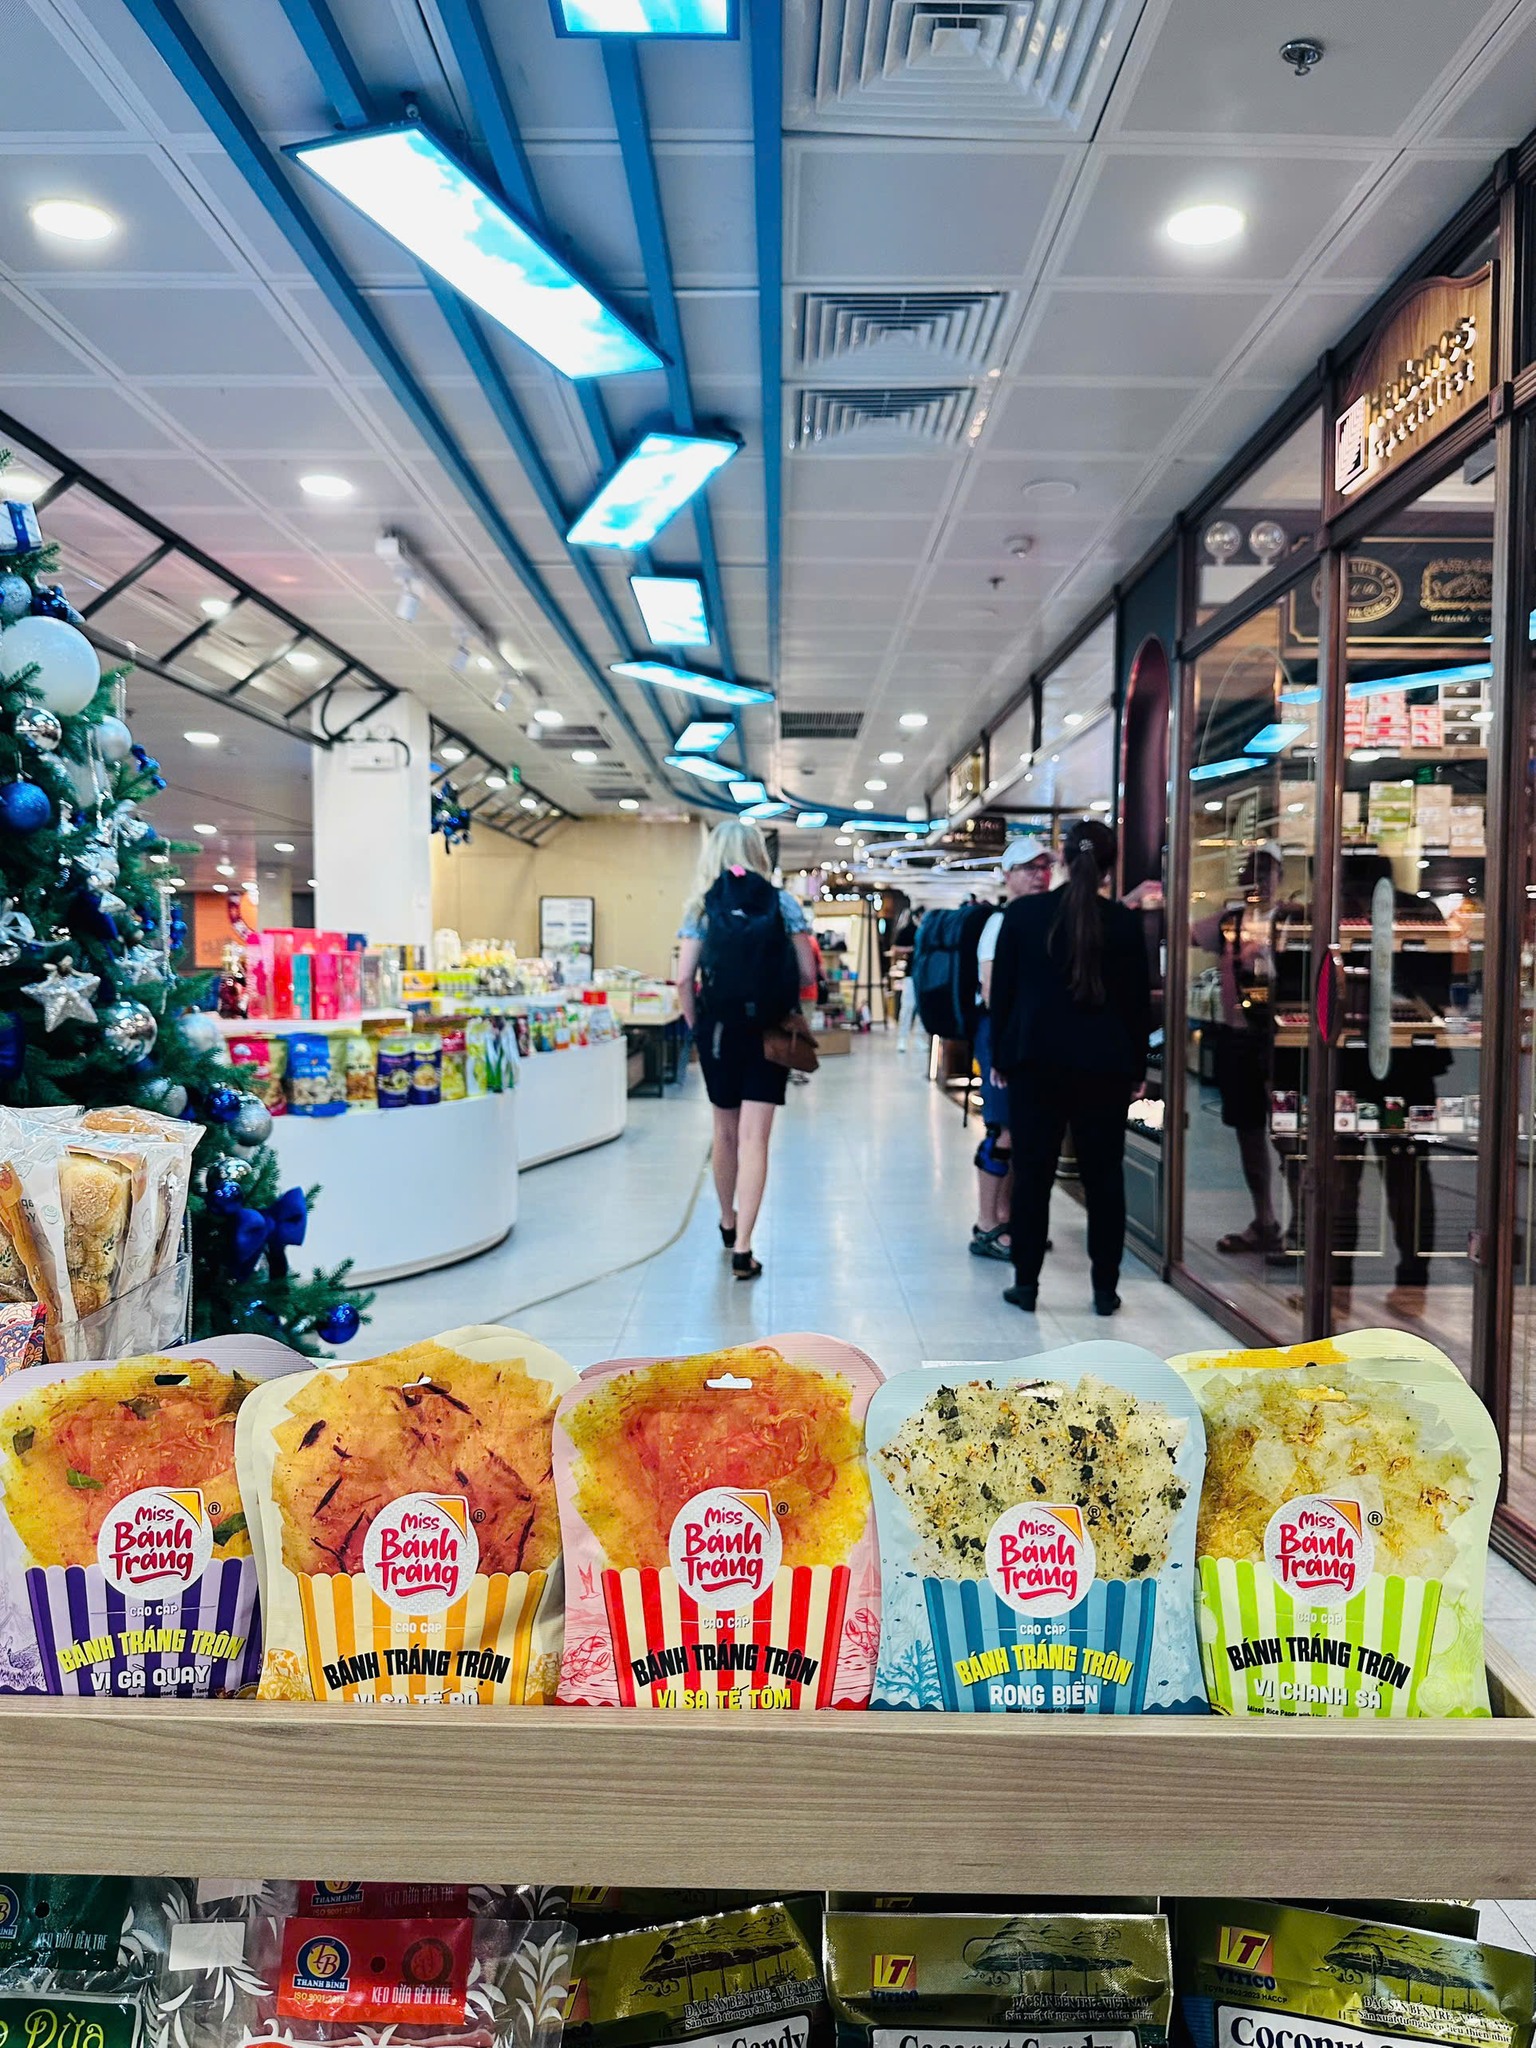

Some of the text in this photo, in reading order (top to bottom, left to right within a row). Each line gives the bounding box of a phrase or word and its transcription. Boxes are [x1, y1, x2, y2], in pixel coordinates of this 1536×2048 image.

[134, 1506, 174, 1525] Miss
[401, 1512, 440, 1533] Miss
[703, 1507, 743, 1528] Miss
[1018, 1519, 1056, 1539] Miss
[1298, 1510, 1335, 1530] Miss
[114, 1519, 193, 1553] Bánh
[380, 1528, 458, 1562] Bánh
[684, 1522, 762, 1557] Bánh
[999, 1534, 1075, 1567] Bánh
[1279, 1524, 1354, 1559] Bánh
[108, 1550, 194, 1580] Tráng
[375, 1559, 460, 1597] Tráng
[680, 1554, 764, 1590] Tráng
[1275, 1554, 1356, 1592] Tráng
[997, 1563, 1078, 1600] Tráng
[130, 1605, 152, 1617] CAO
[703, 1617, 724, 1629] CAO
[1297, 1612, 1318, 1623] CAO
[1020, 1624, 1042, 1635] CAO
[56, 1625, 246, 1673] BÁNH TRÁNG TRỘN
[631, 1639, 819, 1688] BÁNH TRÁNG TRỘN
[954, 1639, 1134, 1686] BÁNH TRÁNG TRỘN
[1226, 1633, 1411, 1690] BÁNH TRÁNG TRỘN
[91, 1664, 211, 1695] VỊ GÀ QUAY
[322, 1643, 511, 1691] BÁNH TRÁNG TRỘN
[682, 1689, 709, 1709] SA
[990, 1676, 1098, 1706] RONG BIỂN
[1254, 1678, 1382, 1709] VỊ CHANH SẢ
[1247, 1705, 1264, 1714] Mixed
[1266, 1707, 1279, 1716] Rice
[314, 1894, 341, 1904] THANH
[294, 1992, 308, 2001] ISO
[296, 1978, 346, 1990] THANH BÌNH
[372, 1986, 388, 2006] KẸO
[434, 1987, 451, 2004] TRE
